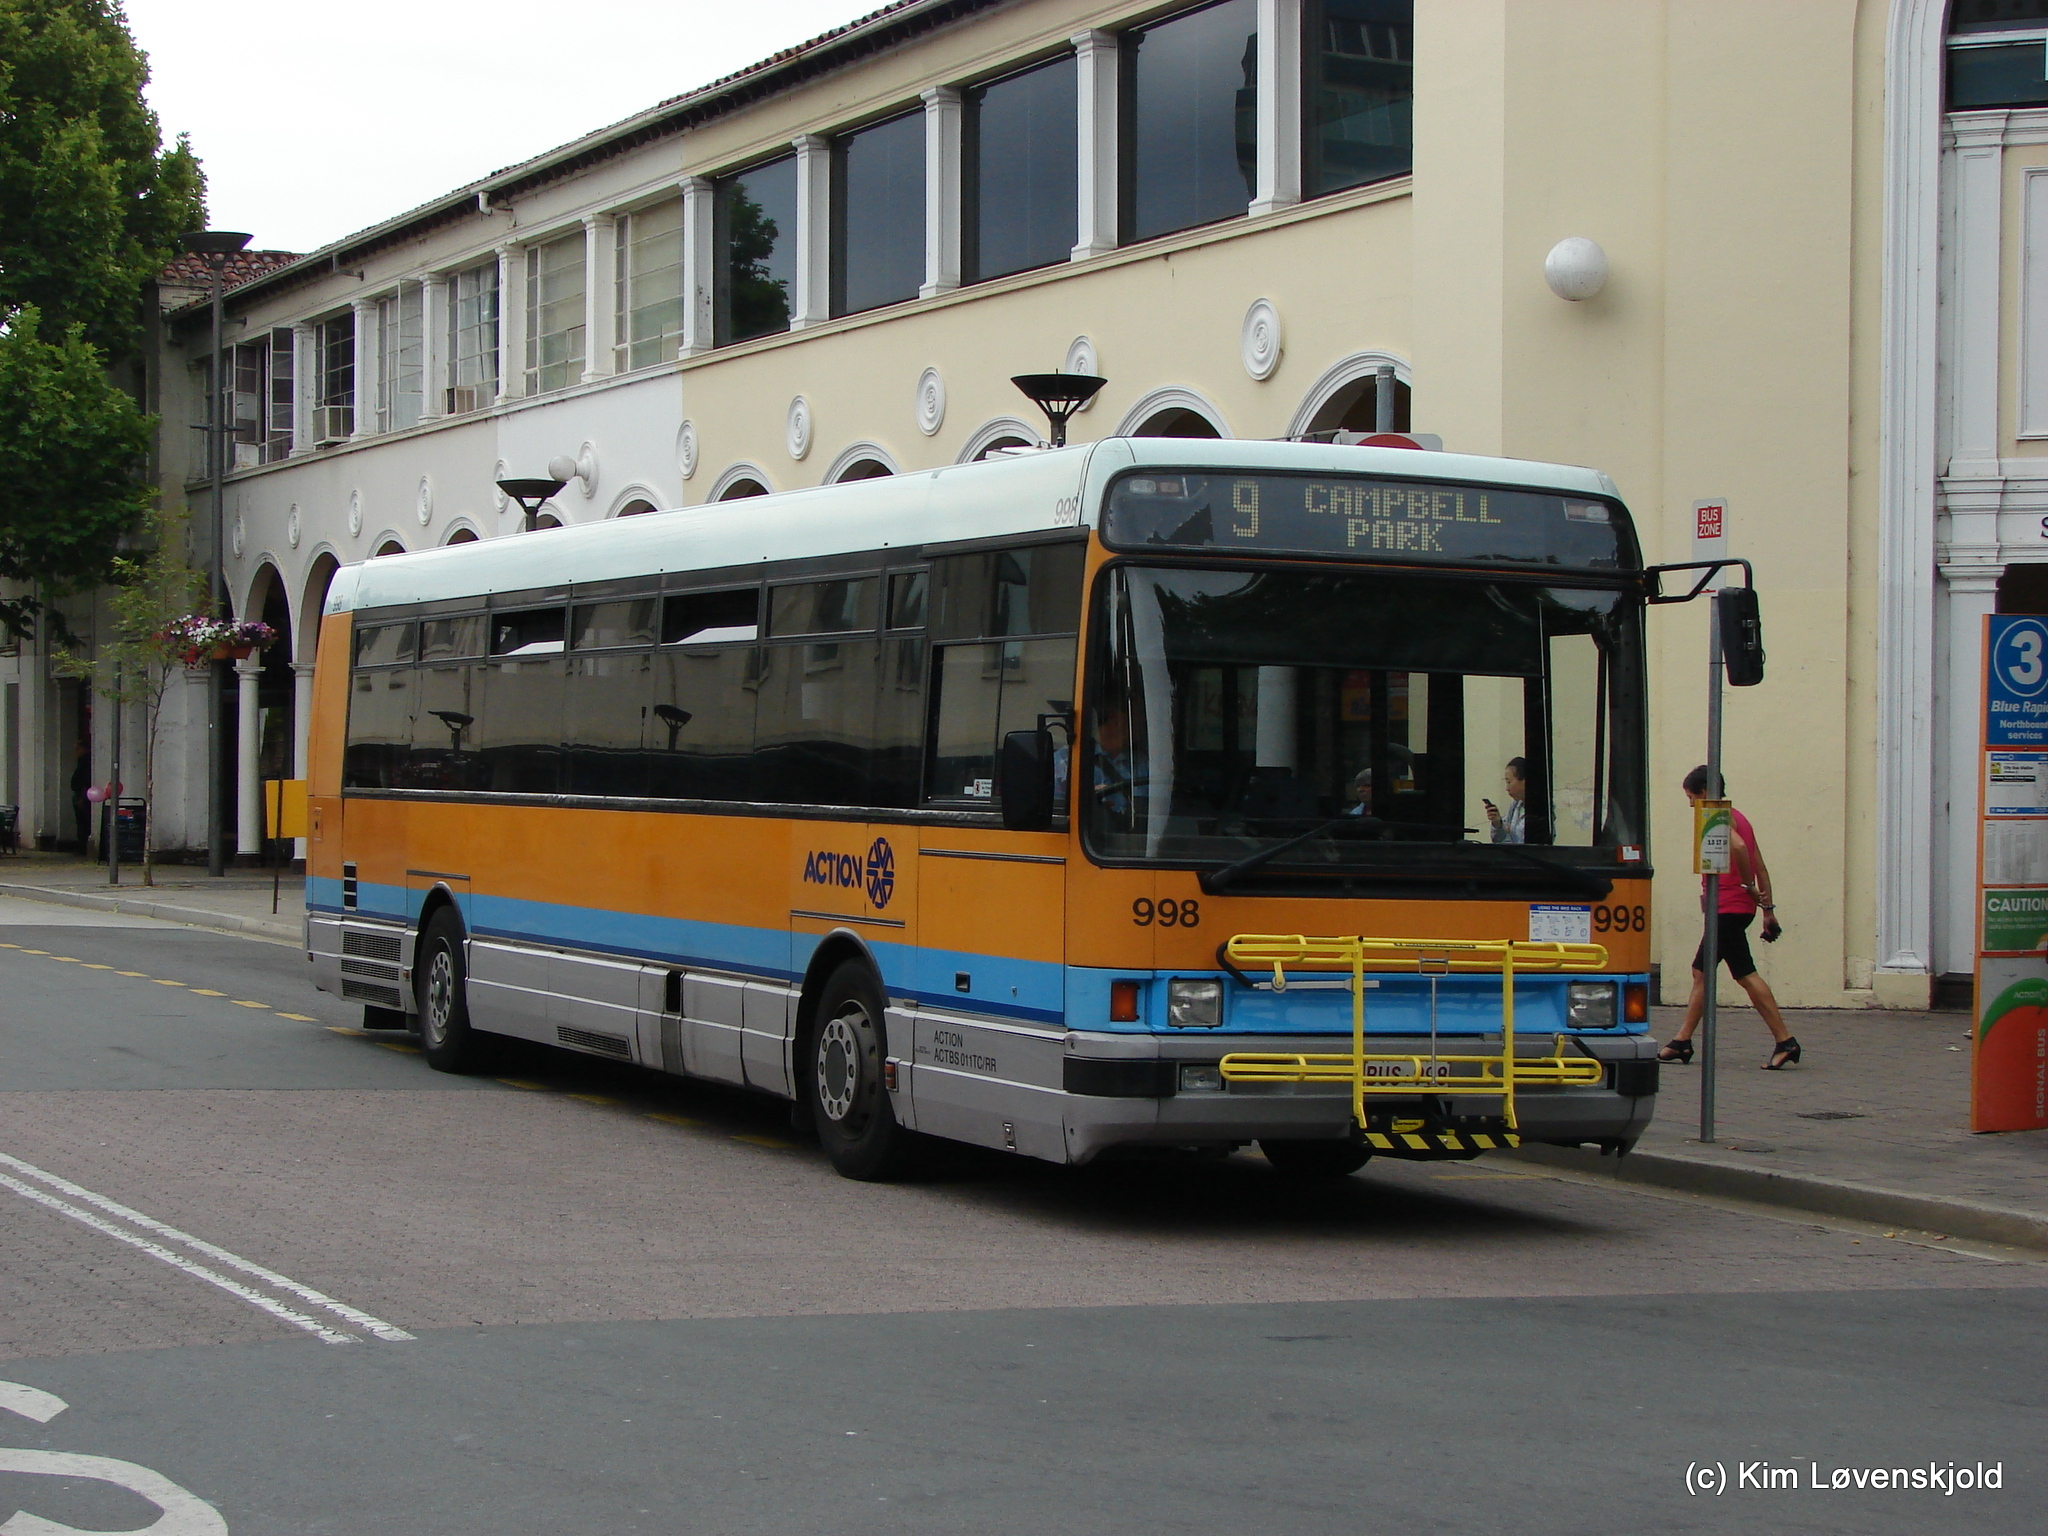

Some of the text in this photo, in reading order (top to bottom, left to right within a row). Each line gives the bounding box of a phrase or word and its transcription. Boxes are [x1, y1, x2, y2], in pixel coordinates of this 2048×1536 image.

[1054, 496, 1078, 525] 998
[1233, 480, 1259, 538] 9
[1304, 484, 1501, 524] CAMPBELL
[1701, 509, 1719, 522] BUS
[1347, 518, 1443, 552] PARK
[1698, 523, 1721, 536] ZONE
[2008, 630, 2043, 685] 3
[1990, 700, 2020, 712] Blue
[2007, 731, 2043, 739] services
[804, 850, 862, 889] ACTION
[1132, 897, 1200, 928] 998
[1593, 905, 1646, 933] 998
[1987, 897, 2048, 912] CAUTION
[933, 1029, 963, 1048] ACTION
[2036, 1028, 2046, 1119] SIGNAL BUS
